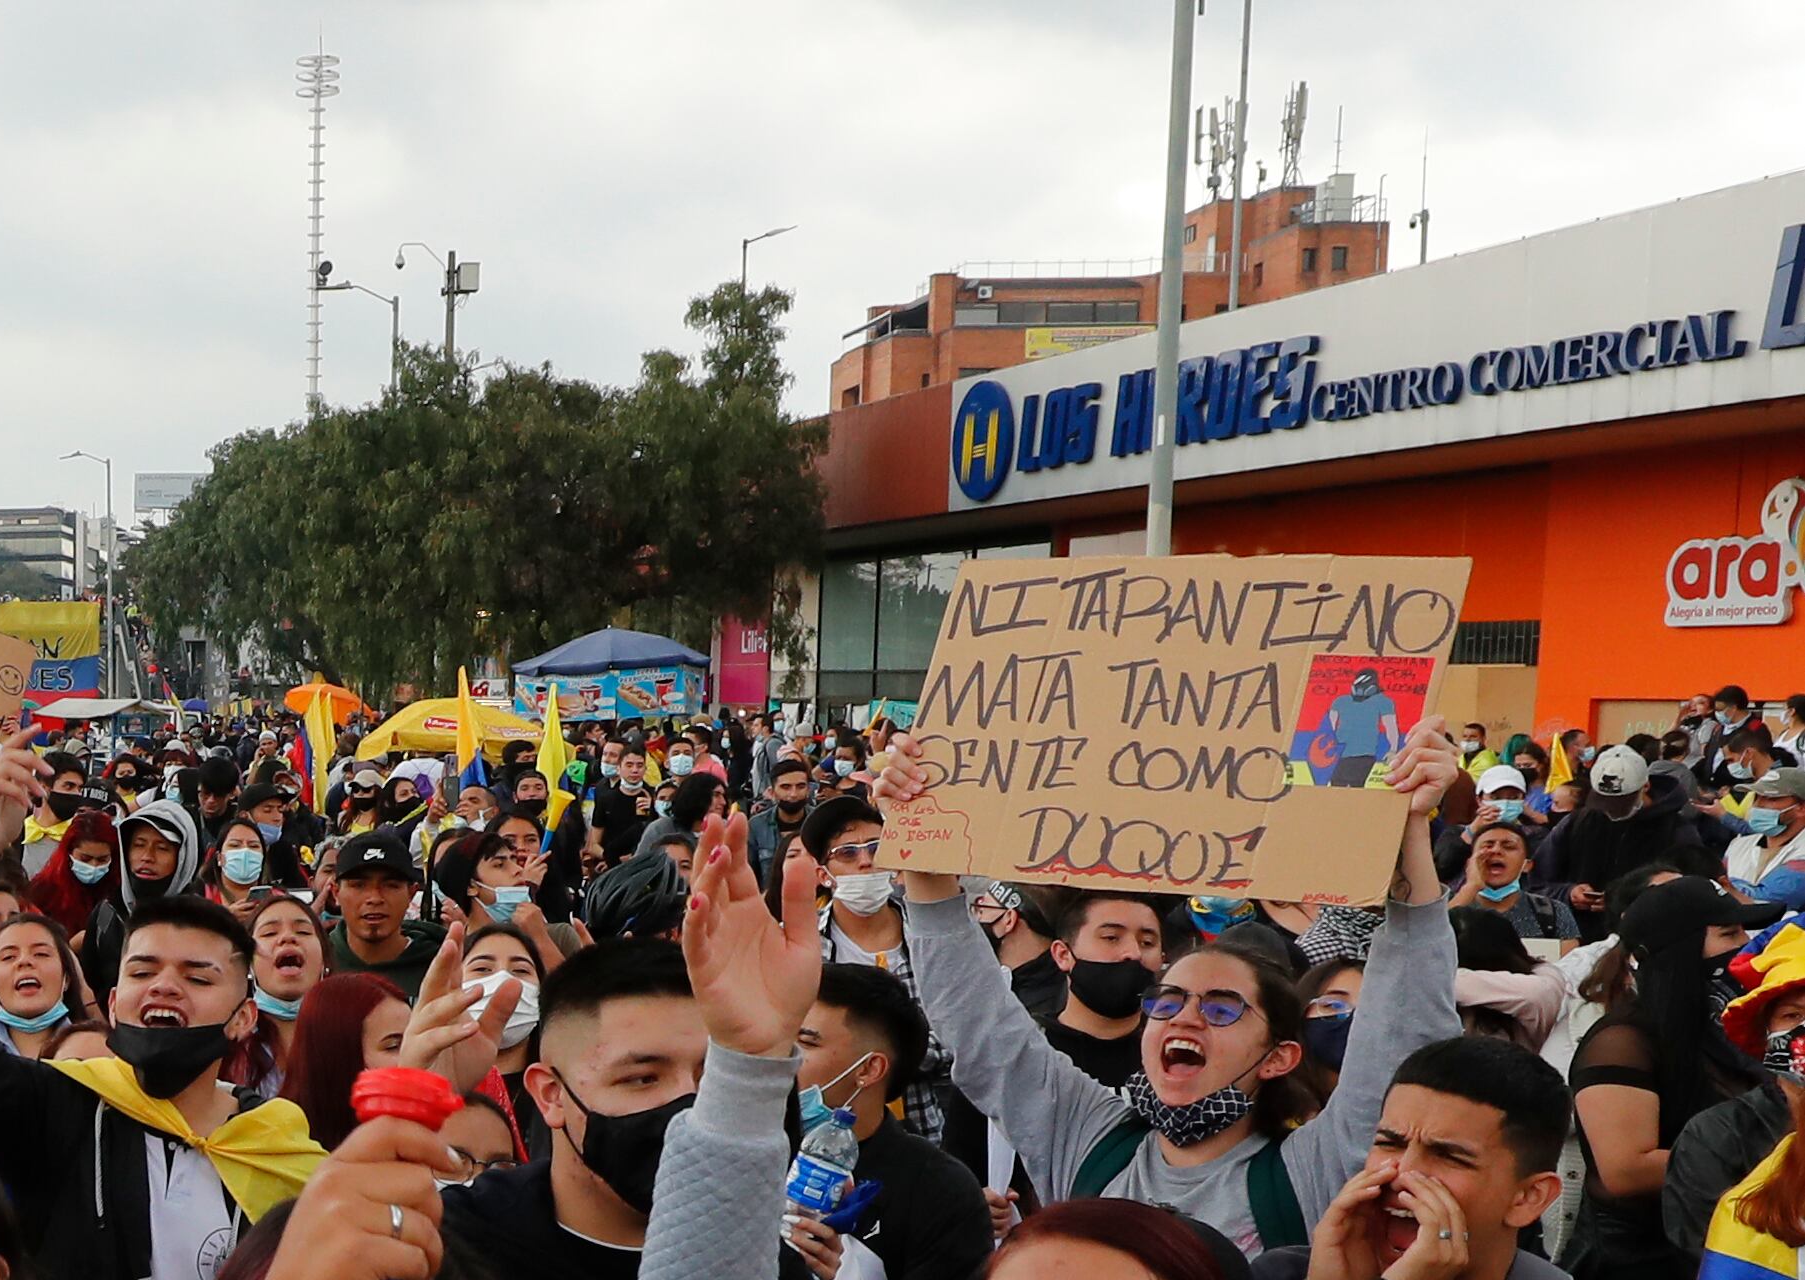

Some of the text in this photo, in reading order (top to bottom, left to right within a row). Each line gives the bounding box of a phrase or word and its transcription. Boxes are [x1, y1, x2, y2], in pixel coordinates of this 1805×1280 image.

[1310, 309, 1749, 422] CENTRO COMERCIAL
[1017, 335, 1321, 473] LOS HROES
[1672, 541, 1781, 601] ara
[947, 577, 1059, 640] NI
[1670, 603, 1778, 620] Alegría al mejor precio
[915, 651, 1282, 734] MATA TANTA
[1108, 741, 1294, 803] COMO
[882, 829, 899, 840] NO
[898, 817, 922, 827] QUE
[1016, 805, 1268, 886] DUQUE
